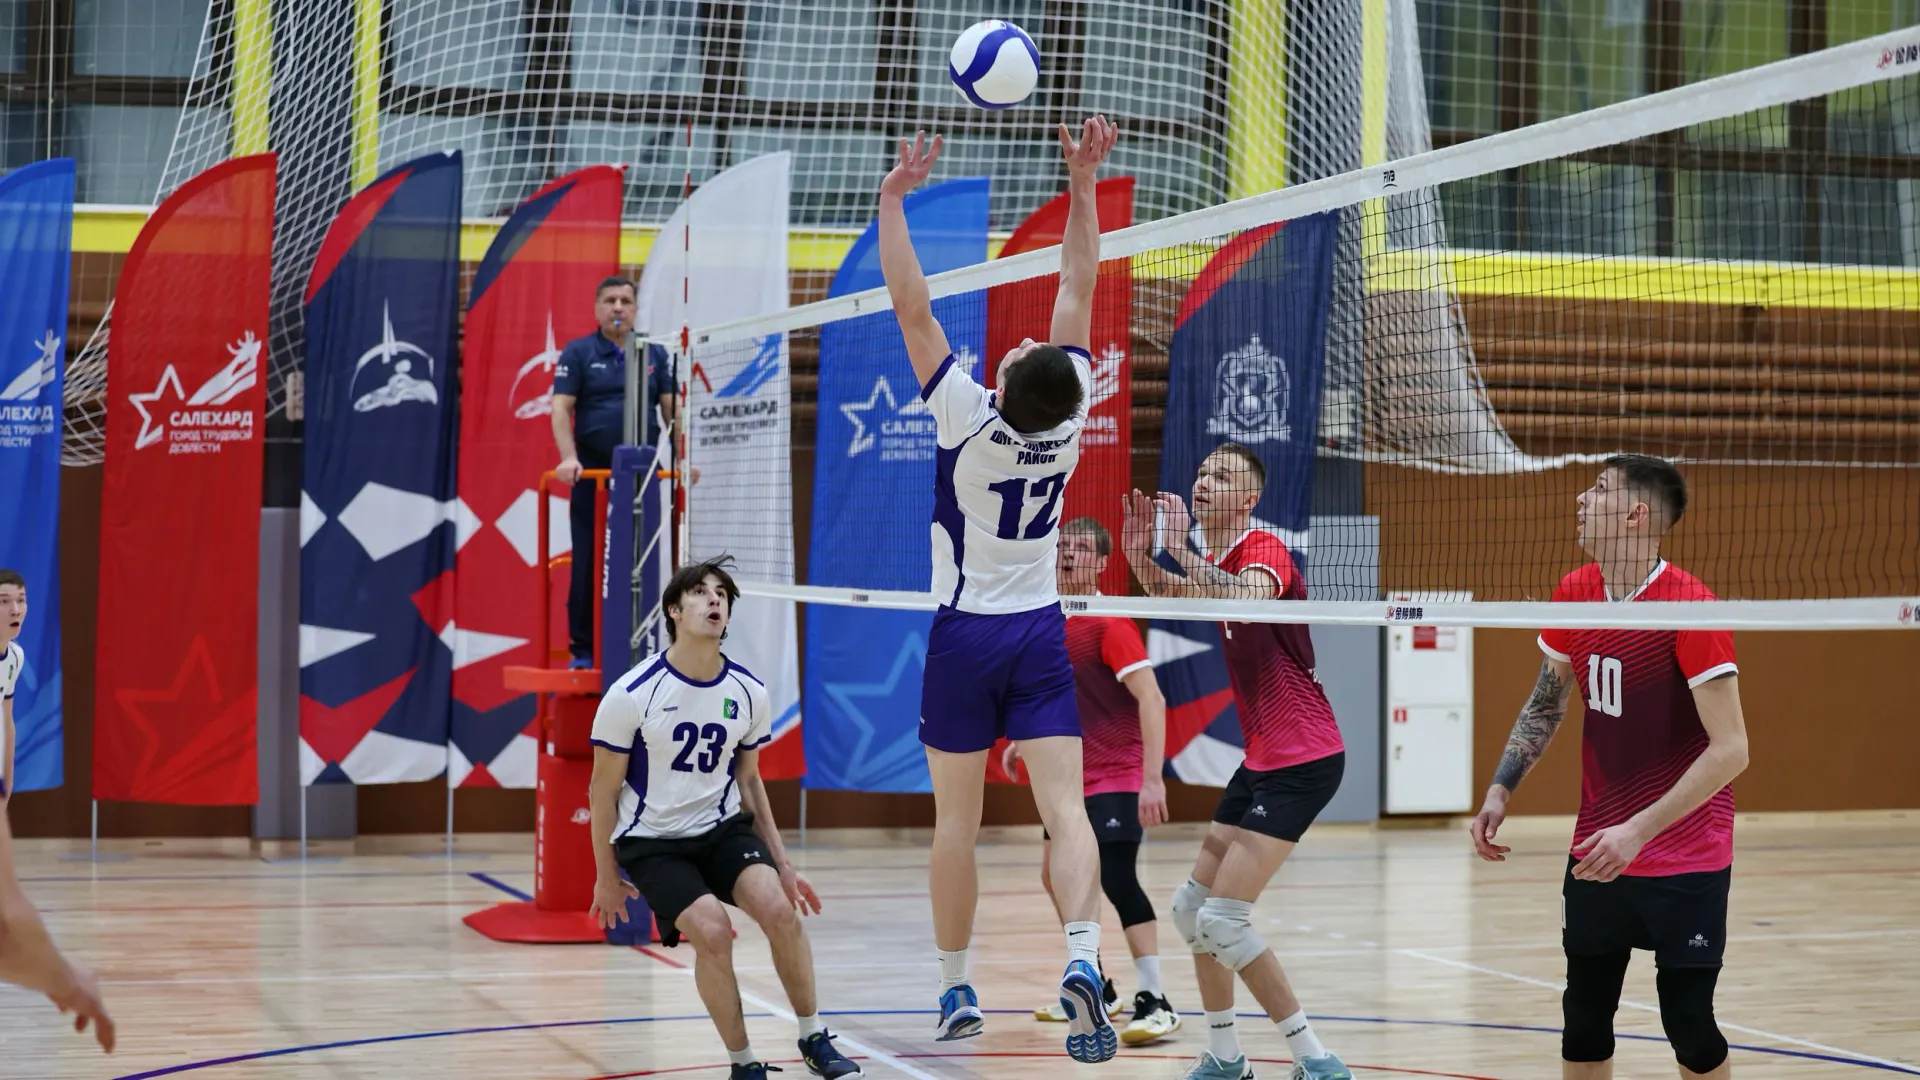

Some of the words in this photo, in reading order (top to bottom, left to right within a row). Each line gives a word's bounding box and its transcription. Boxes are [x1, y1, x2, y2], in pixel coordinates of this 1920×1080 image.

[169, 410, 254, 428] САЛЕХАРД
[169, 429, 201, 441] ГОРОД
[203, 429, 254, 441] ТРУДОВОЙ
[168, 442, 222, 455] ДОБЛЕСТИ
[988, 472, 1067, 540] 12
[1588, 654, 1623, 718] 10
[671, 721, 728, 774] 23
[1285, 1025, 1307, 1038] adidas
